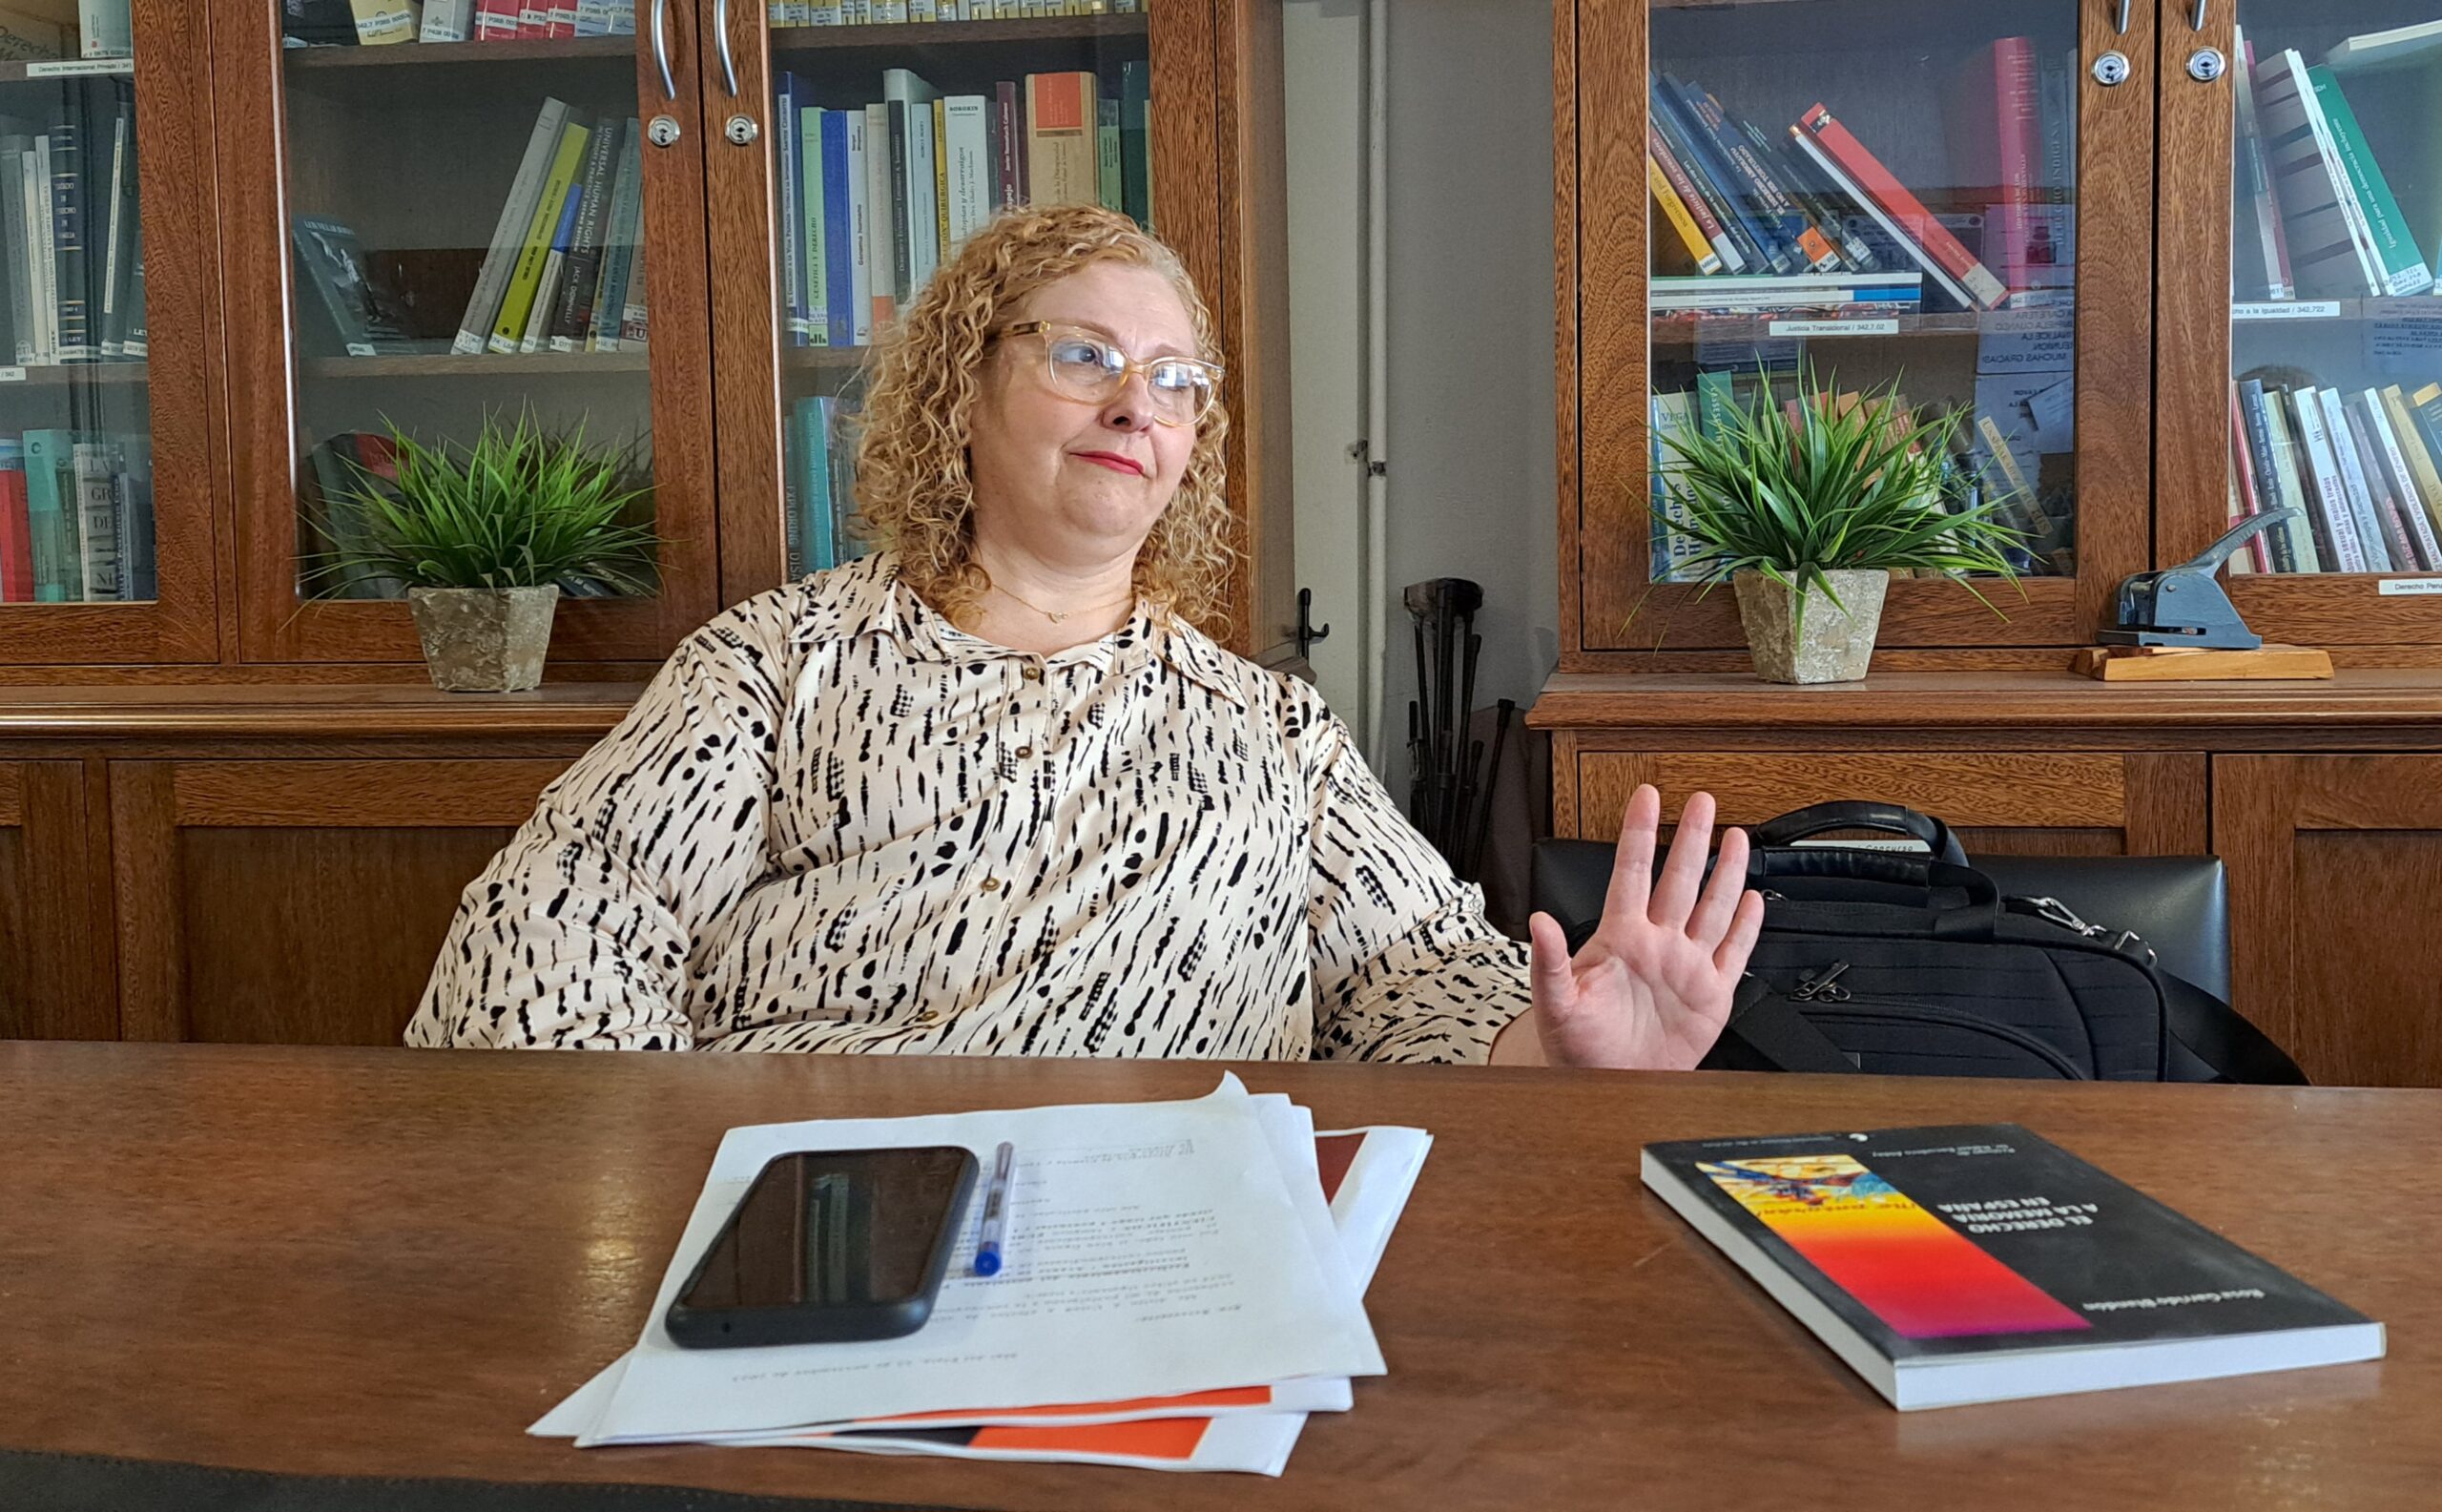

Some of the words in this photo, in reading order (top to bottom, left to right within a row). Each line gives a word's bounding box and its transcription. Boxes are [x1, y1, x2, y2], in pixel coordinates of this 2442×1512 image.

[2330, 115, 2352, 153] incluyente
[594, 125, 611, 176] UNIVERSAL
[956, 145, 967, 196] desarraigos
[2346, 150, 2370, 191] democracia
[587, 179, 602, 217] HUMAN
[937, 171, 947, 221] QUIRÚRGICA
[579, 219, 594, 255] RIGHTS
[2376, 217, 2397, 248] Igualdad
[2261, 305, 2290, 315] Igualdad
[2321, 475, 2334, 498] tratos
[785, 486, 798, 546] EXPLORING
[1667, 482, 1687, 556] Deechs
[2327, 497, 2341, 521] malos
[2335, 527, 2349, 551] sexual
[1935, 1198, 2019, 1213] ESPAÑA
[2018, 1195, 2050, 1207] EN
[1950, 1207, 2053, 1223] MEMORIA
[1967, 1217, 2065, 1233] DERECHO
[2081, 1296, 2157, 1314] Blandón
[2155, 1291, 2221, 1308] Garrido
[2220, 1288, 2264, 1302] Rosa
